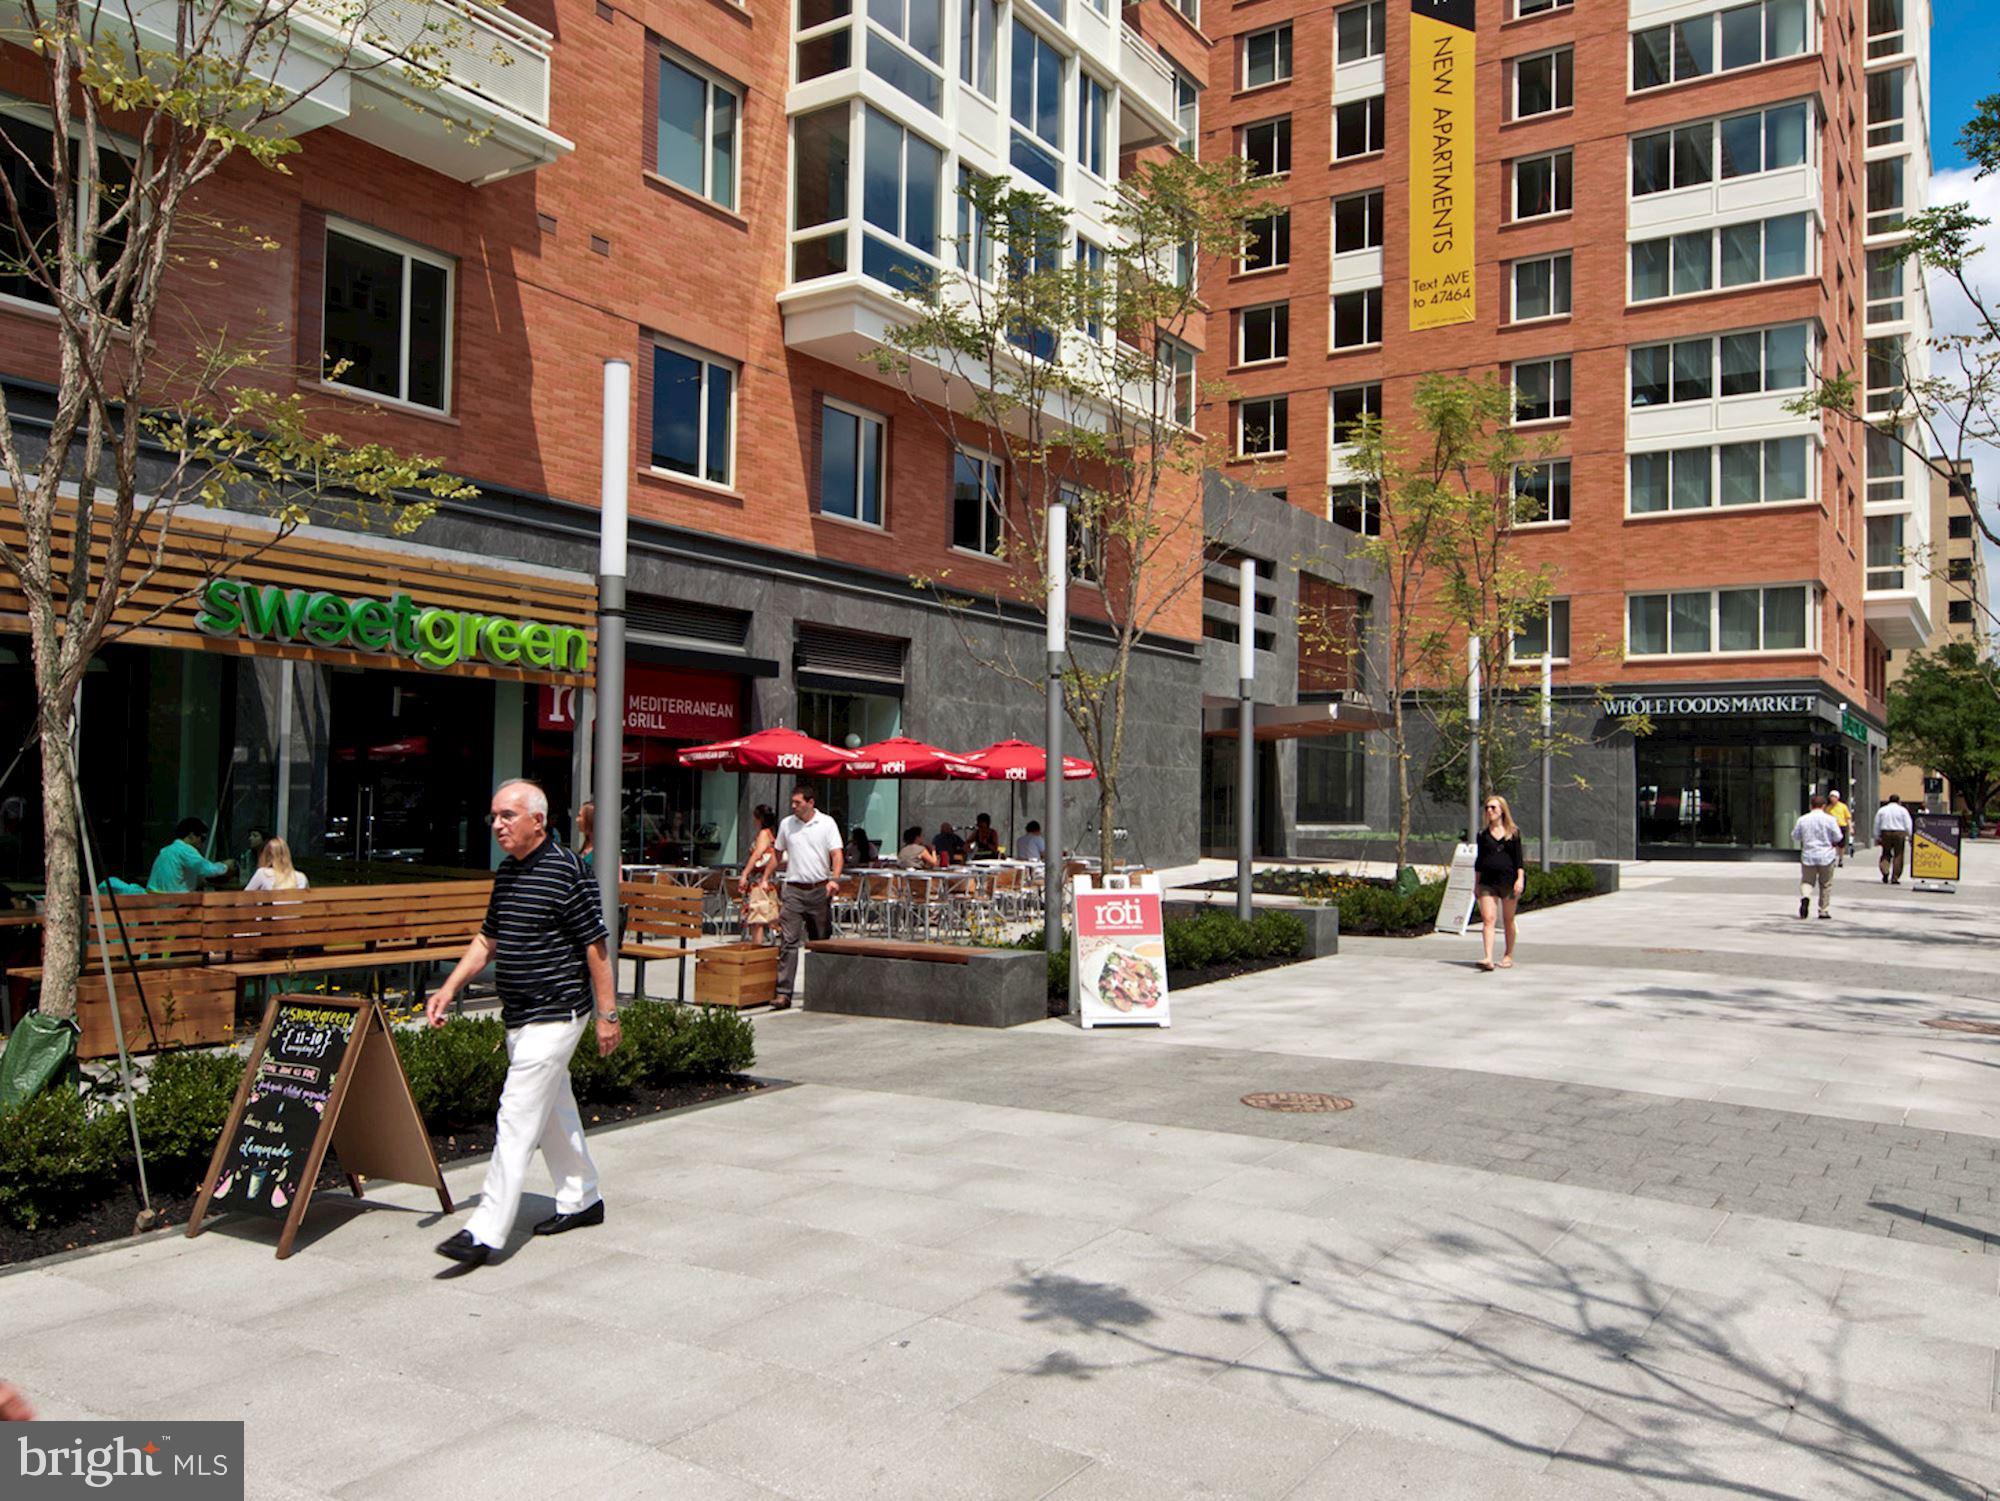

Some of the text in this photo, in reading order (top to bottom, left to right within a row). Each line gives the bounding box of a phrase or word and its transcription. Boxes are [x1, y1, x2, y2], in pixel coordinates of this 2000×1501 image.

[1432, 36, 1454, 254] NEW APARTMENTS
[1412, 270, 1470, 292] Text AVE
[1413, 287, 1471, 308] to 47464
[194, 579, 588, 671] sweetgreen
[629, 695, 734, 718] MEDITERRANEAN
[1602, 695, 1816, 716] WHOLE FOODS MARKET
[628, 712, 666, 729] GRILL
